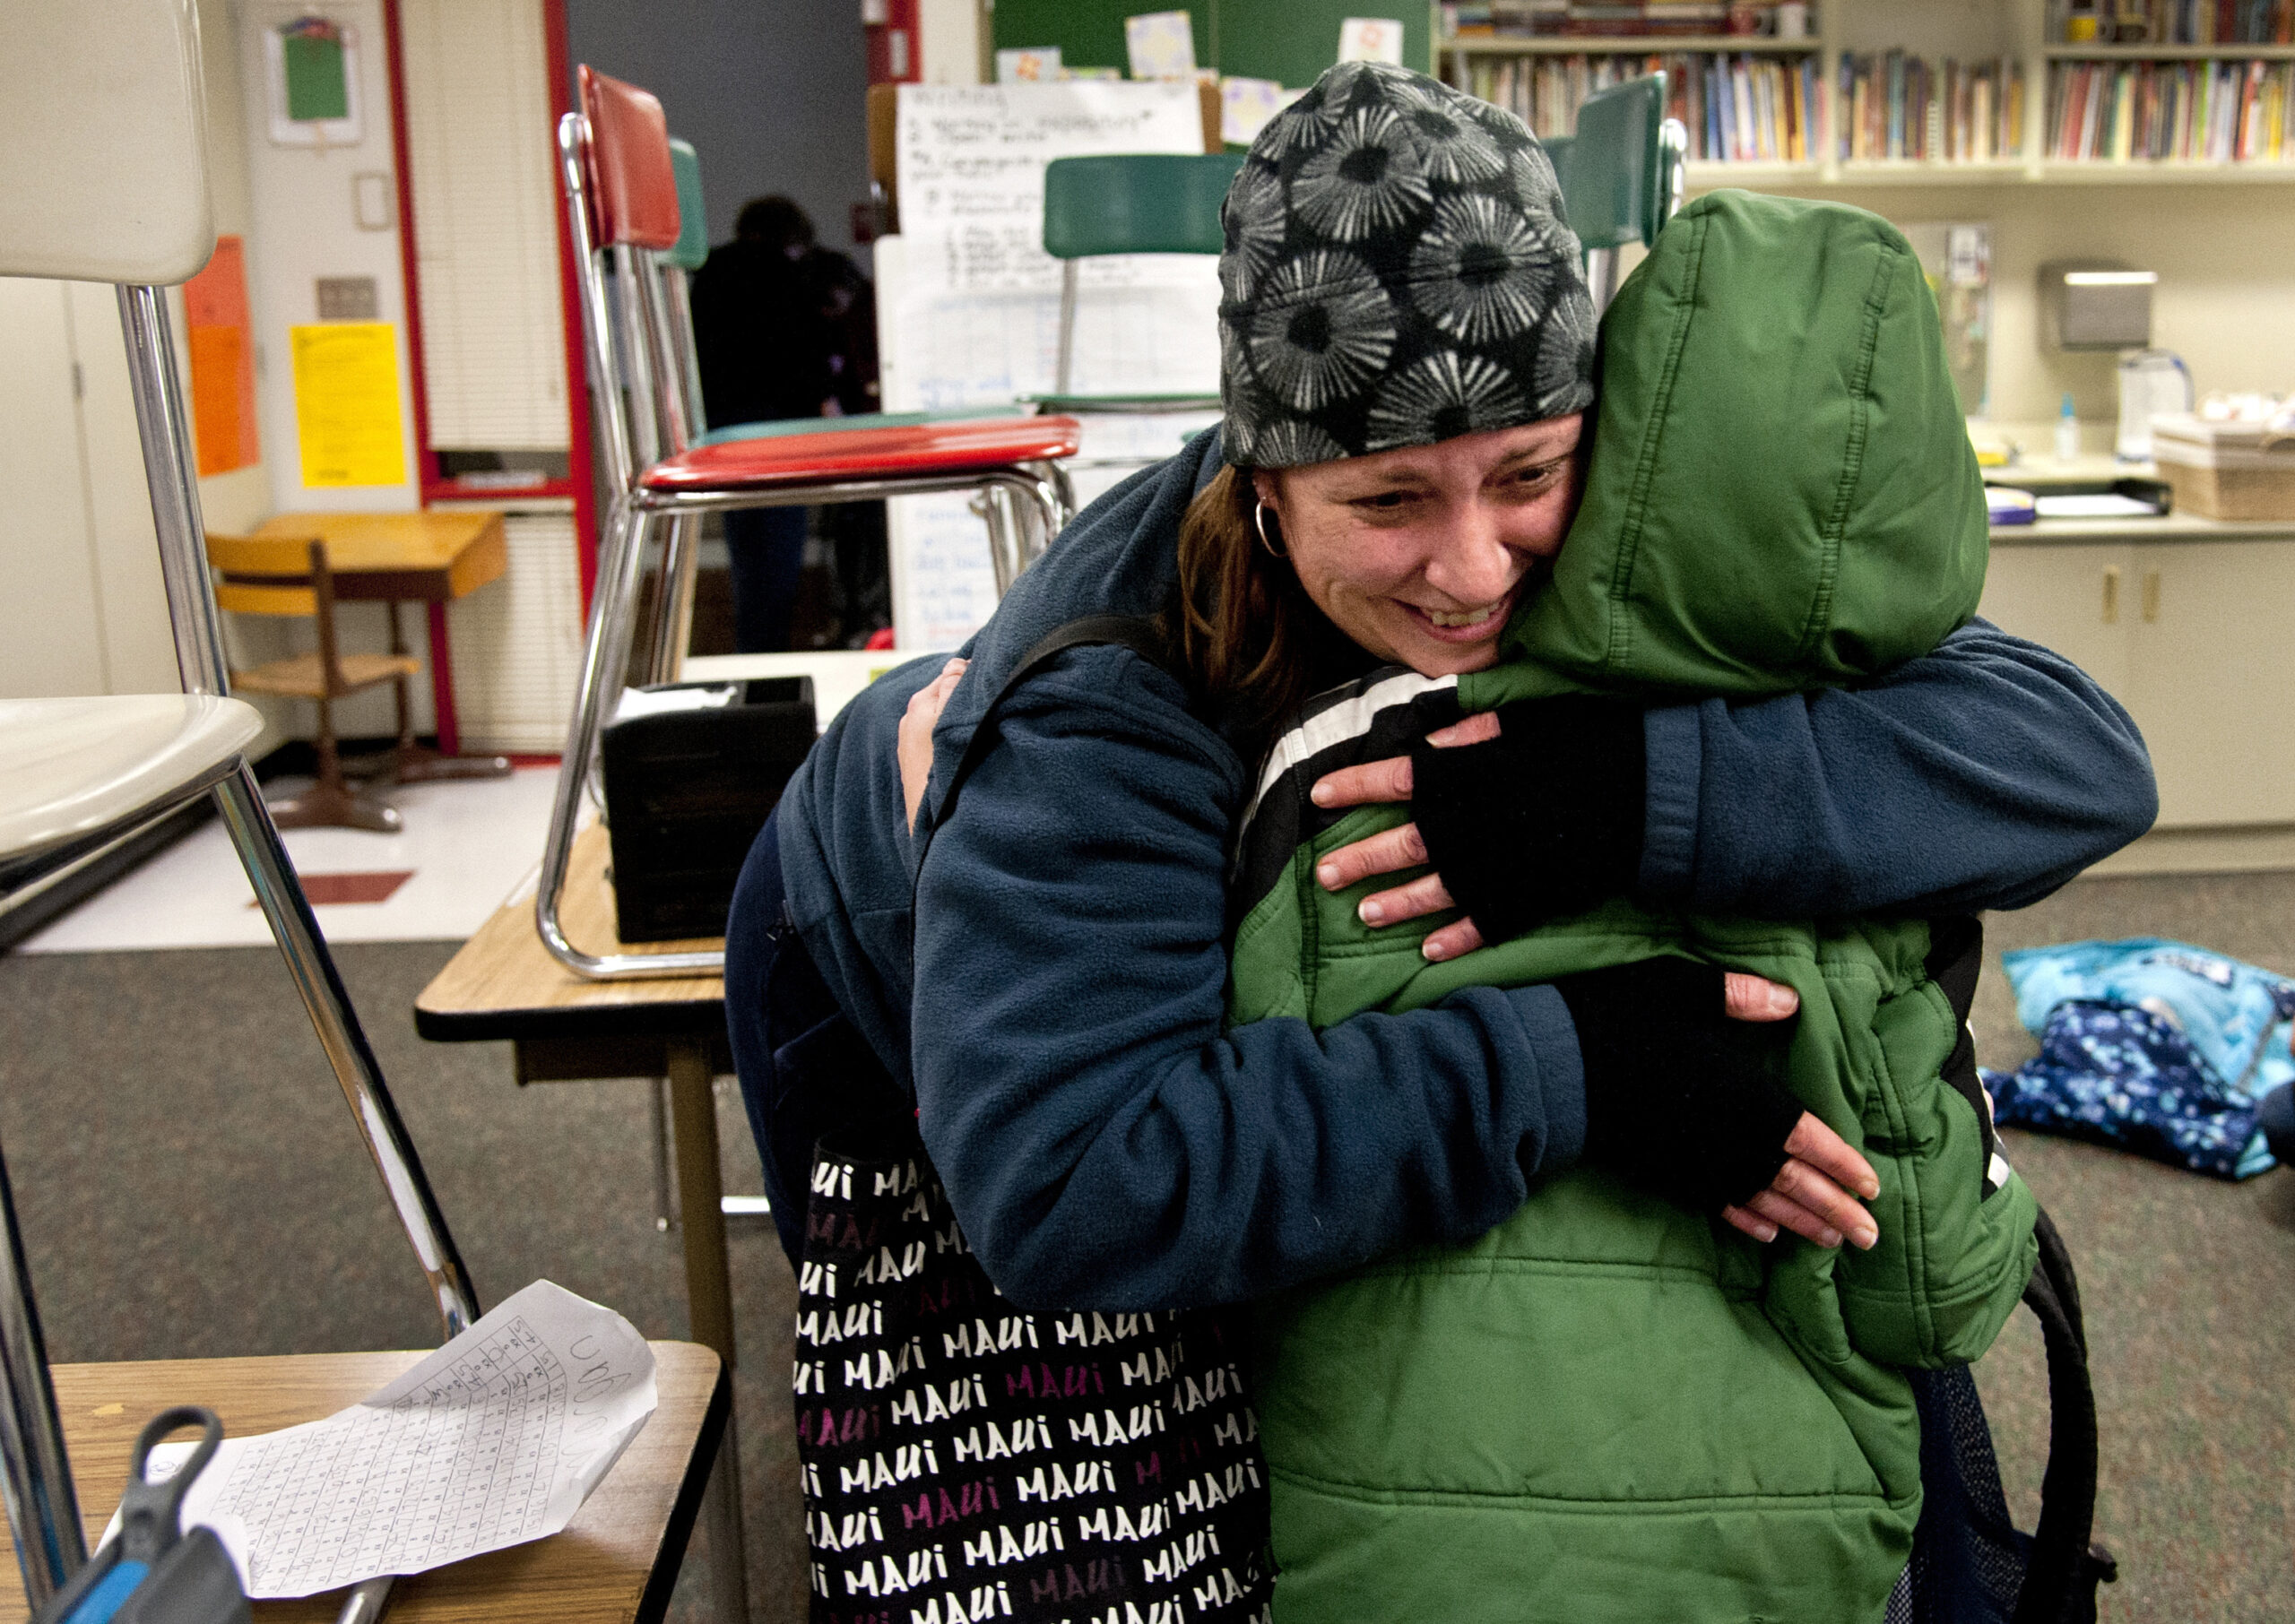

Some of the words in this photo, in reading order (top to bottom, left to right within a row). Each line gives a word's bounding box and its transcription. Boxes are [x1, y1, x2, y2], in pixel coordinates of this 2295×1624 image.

[943, 1315, 1039, 1359] MAUi
[891, 1373, 988, 1425] MAUi
[1006, 1361, 1104, 1398] MAUi
[840, 1439, 940, 1494] MAUi
[954, 1415, 1053, 1463] MAUi
[1069, 1400, 1166, 1447] MAUi
[844, 1544, 948, 1597] MAUi
[964, 1516, 1064, 1567] MAUi
[1078, 1498, 1171, 1542] MAUi
[1175, 1458, 1261, 1515] MAUi
[902, 1476, 1000, 1530] MAUi
[1016, 1460, 1117, 1503] MAUi
[910, 1581, 1013, 1624] MAUi
[1143, 1525, 1221, 1584] MAUi
